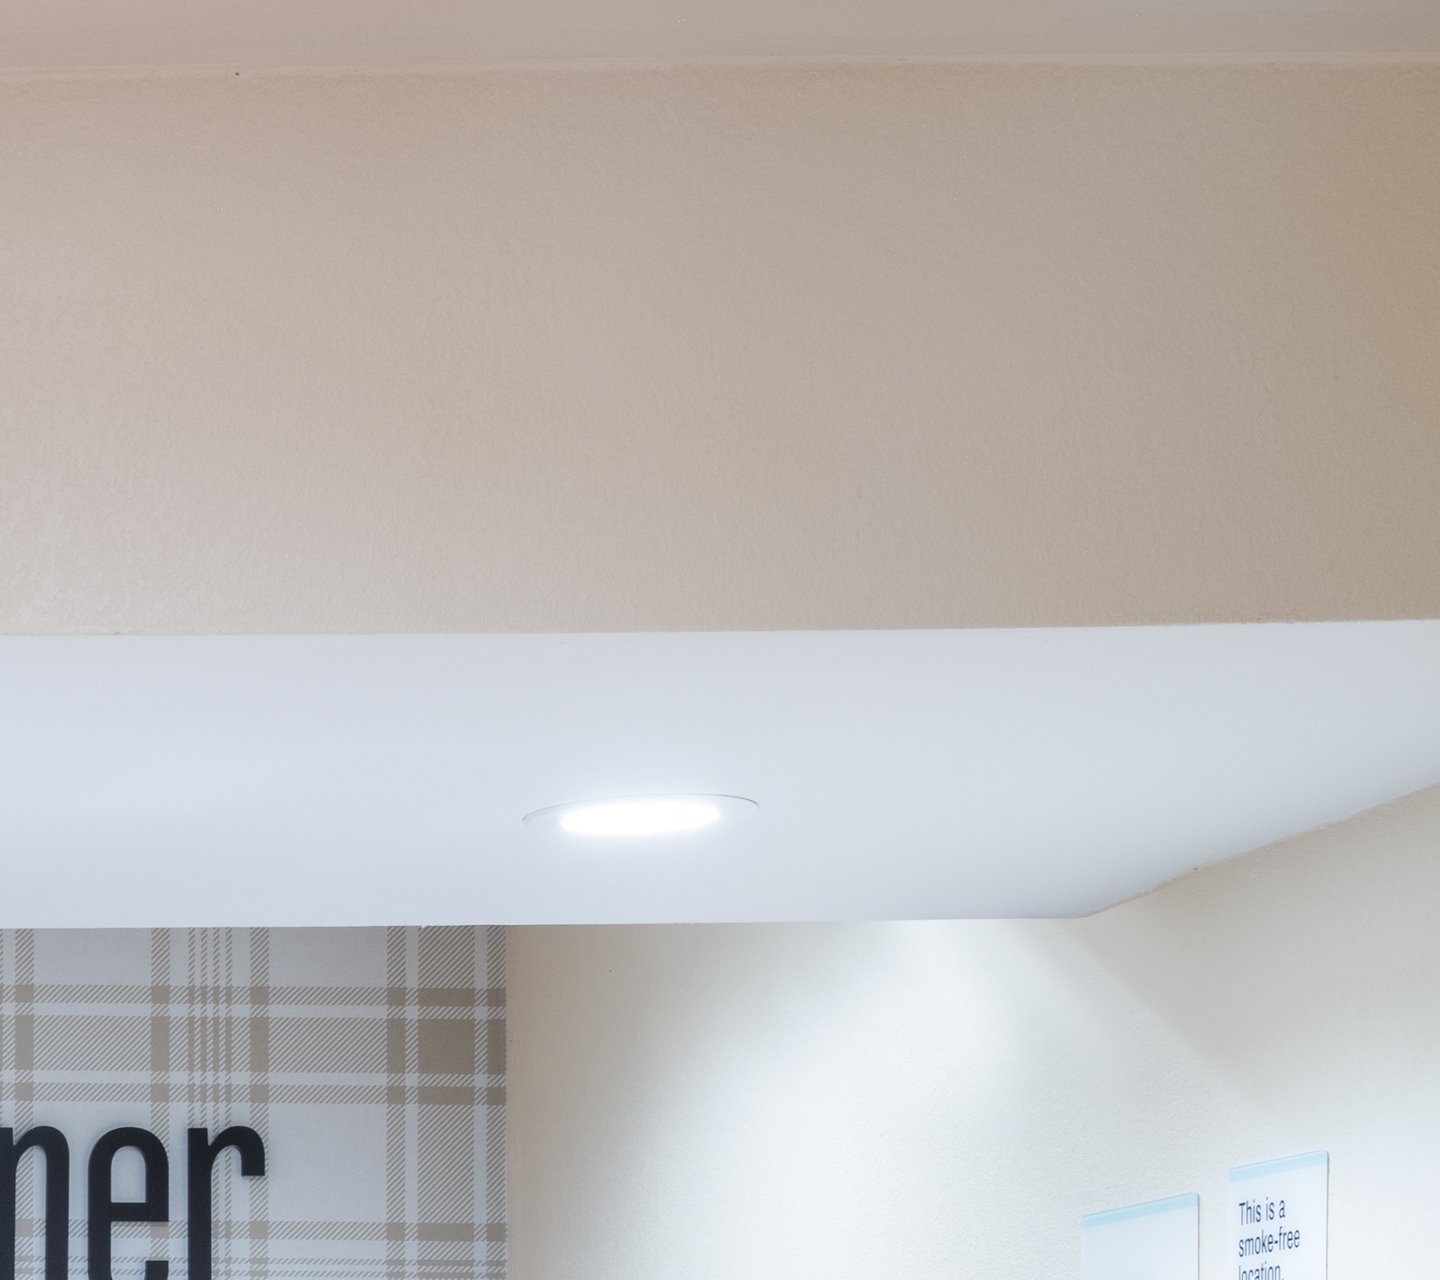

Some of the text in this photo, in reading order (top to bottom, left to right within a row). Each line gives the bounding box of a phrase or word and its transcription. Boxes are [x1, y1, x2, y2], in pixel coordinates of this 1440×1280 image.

[1239, 1197, 1286, 1226] This is a
[1238, 1226, 1300, 1258] smoke-free
